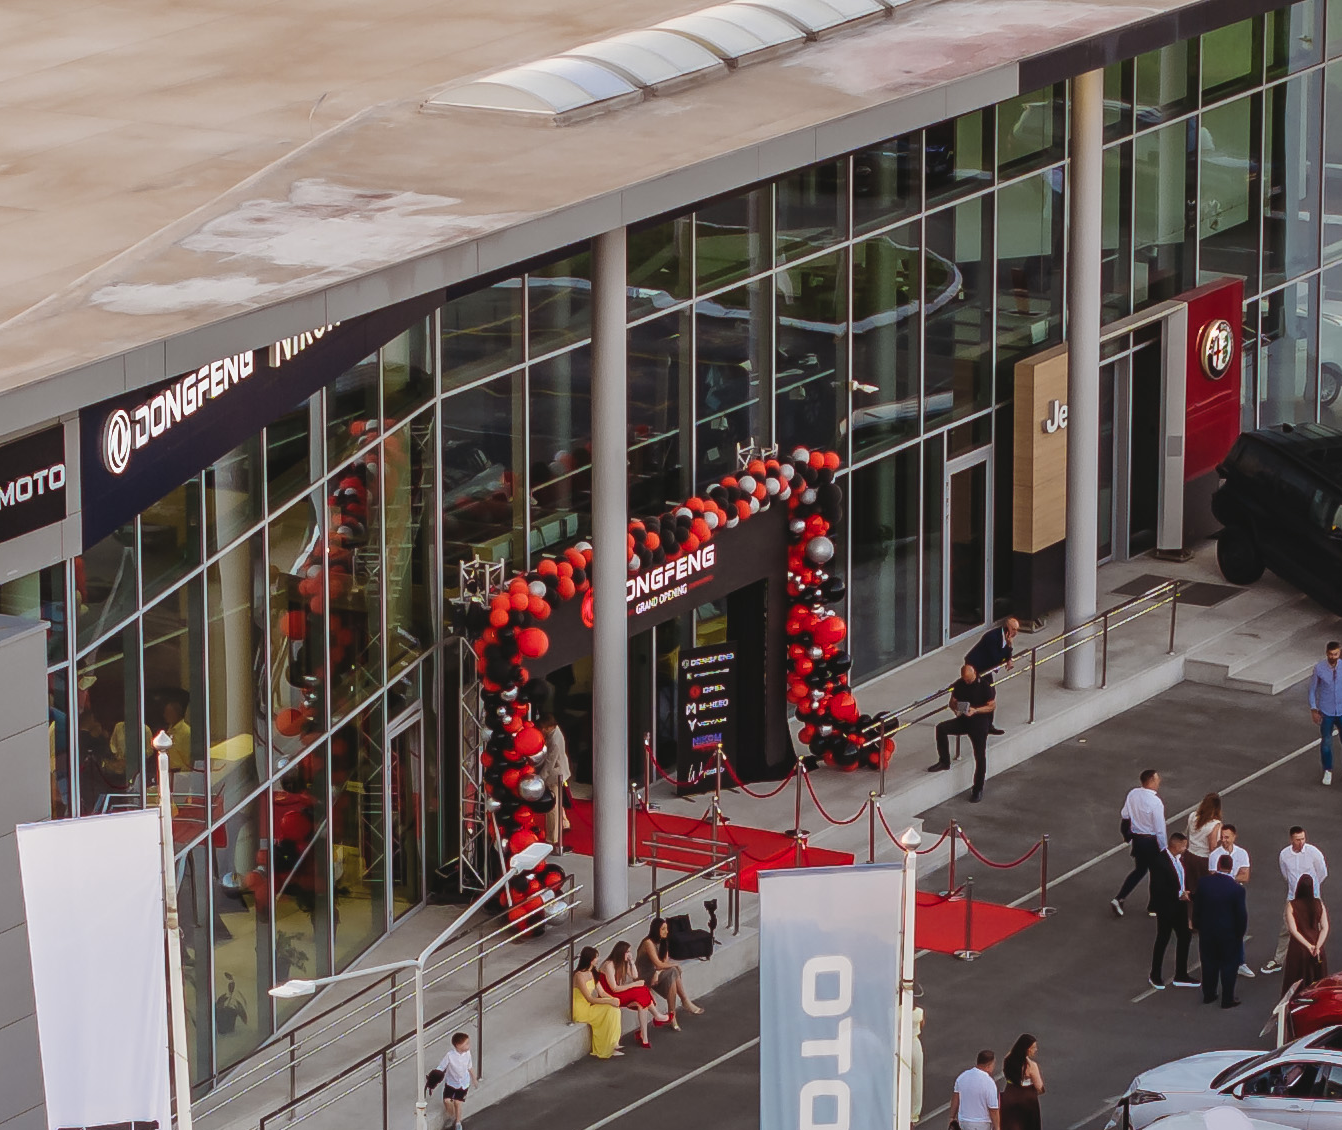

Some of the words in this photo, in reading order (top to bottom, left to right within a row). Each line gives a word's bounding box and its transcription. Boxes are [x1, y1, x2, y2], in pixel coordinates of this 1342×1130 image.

[132, 350, 253, 450] DONGFENG
[626, 543, 715, 602] ONGFENG
[635, 596, 658, 615] GRAND
[659, 583, 688, 605] OPENING
